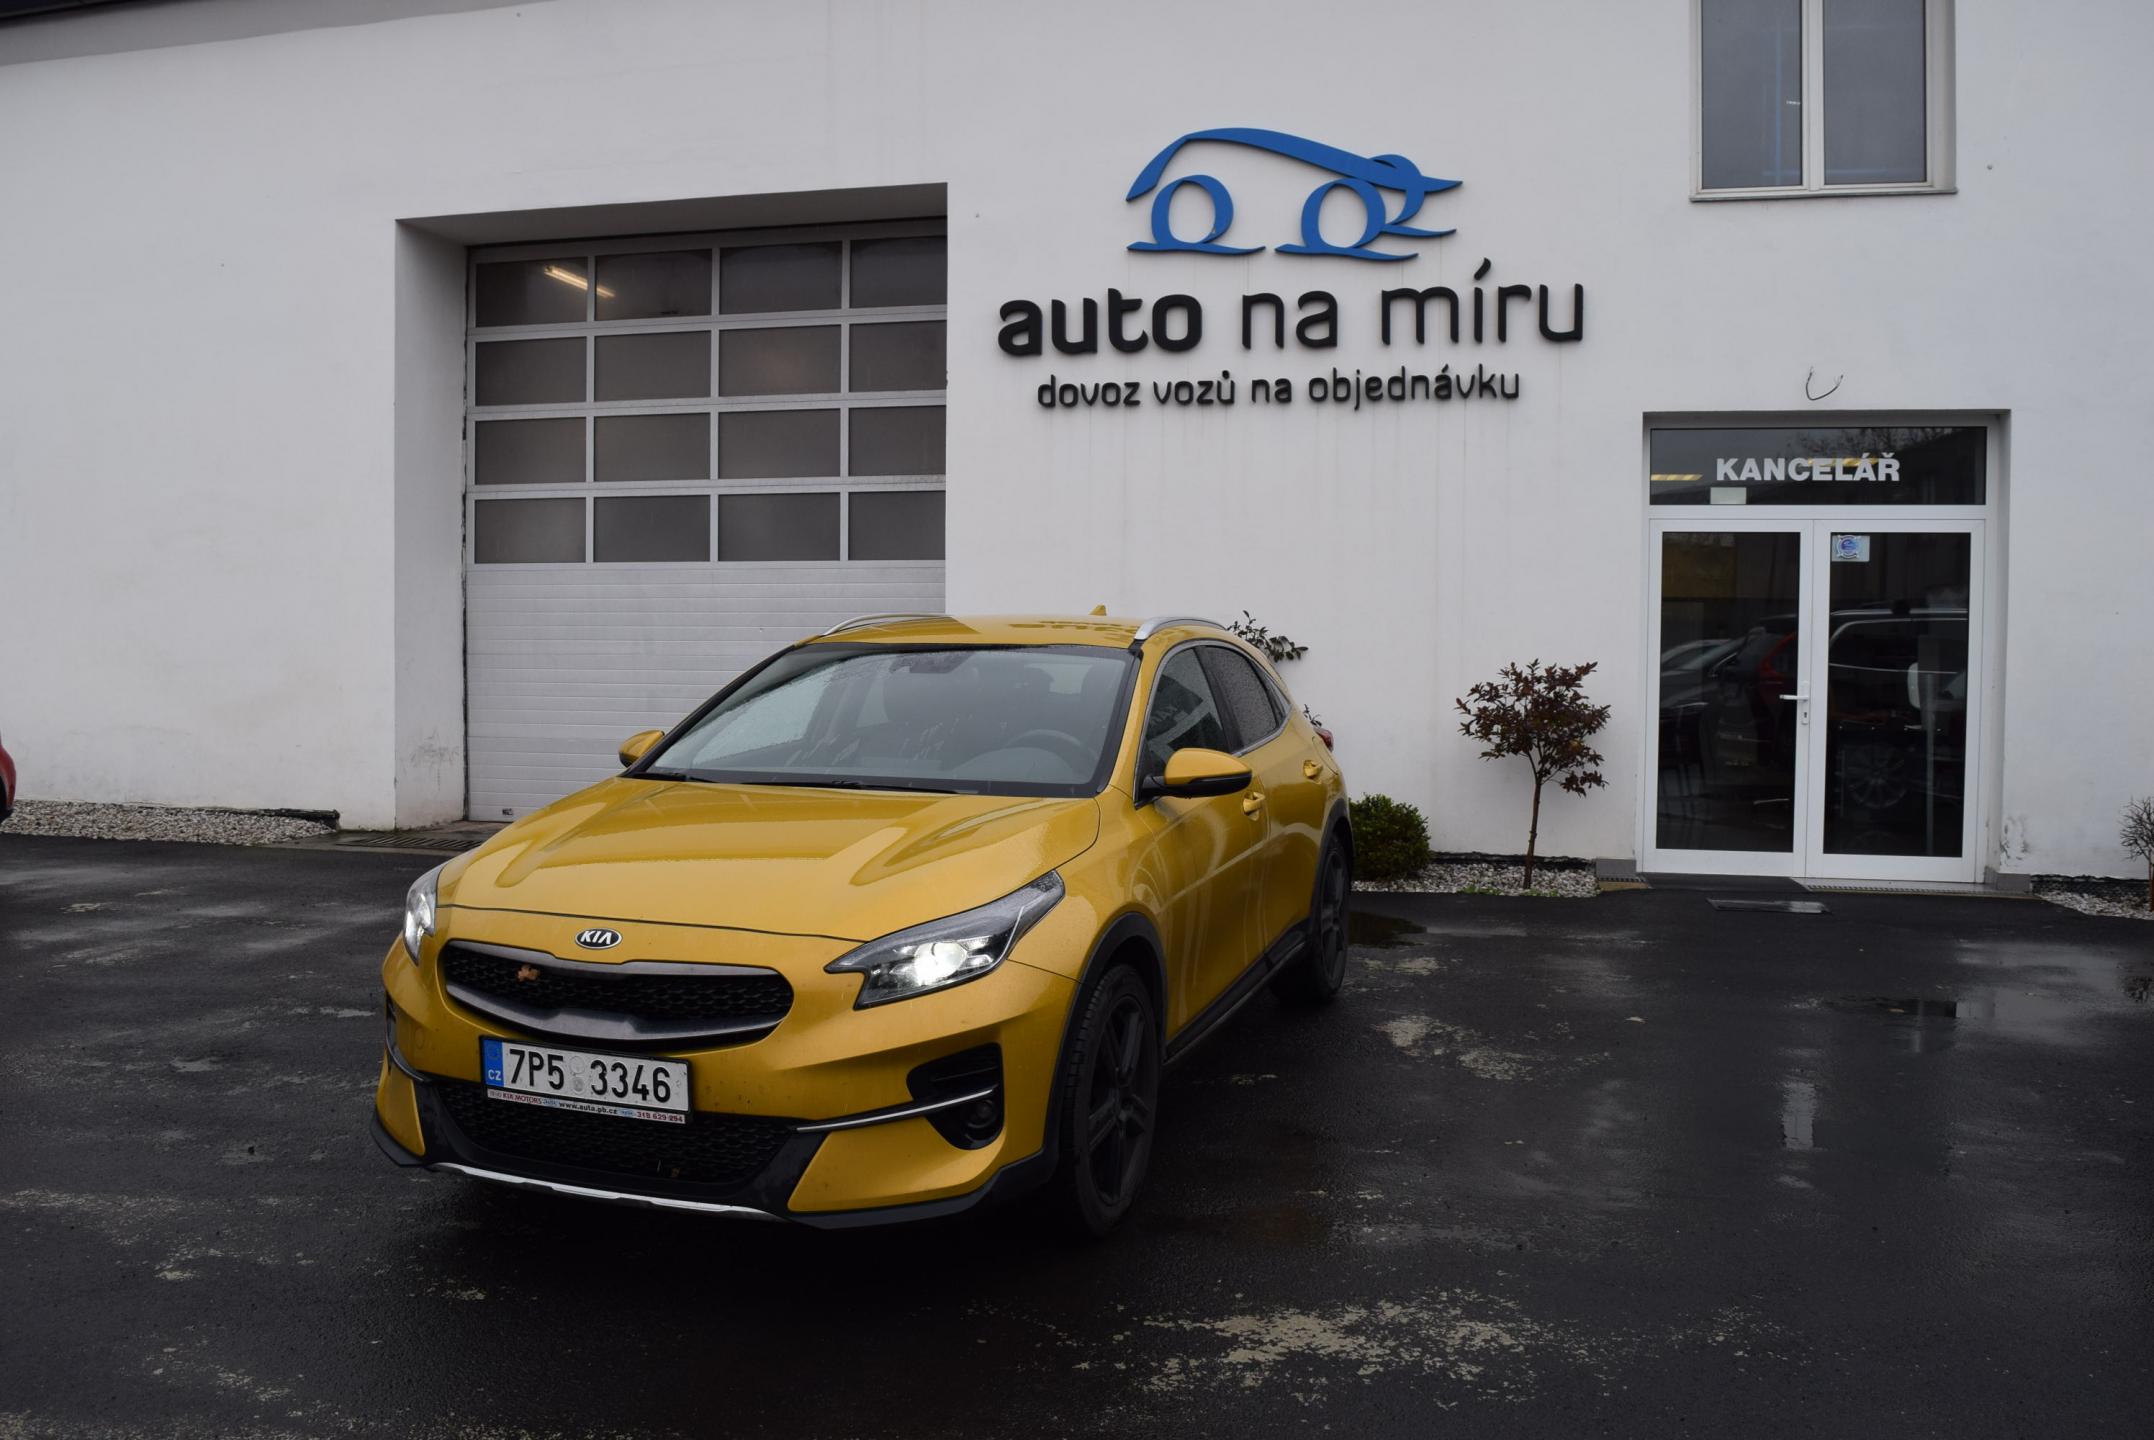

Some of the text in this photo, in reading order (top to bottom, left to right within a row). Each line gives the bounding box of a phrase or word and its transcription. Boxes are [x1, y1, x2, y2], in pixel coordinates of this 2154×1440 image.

[998, 258, 1583, 356] auto na míru
[1037, 364, 1519, 411] dovoz vozů na objednávku
[1716, 452, 1900, 482] KANCELÁŘ
[580, 930, 612, 945] KIA
[488, 1069, 502, 1081] CZ
[509, 1048, 671, 1103] 7P5 3346
